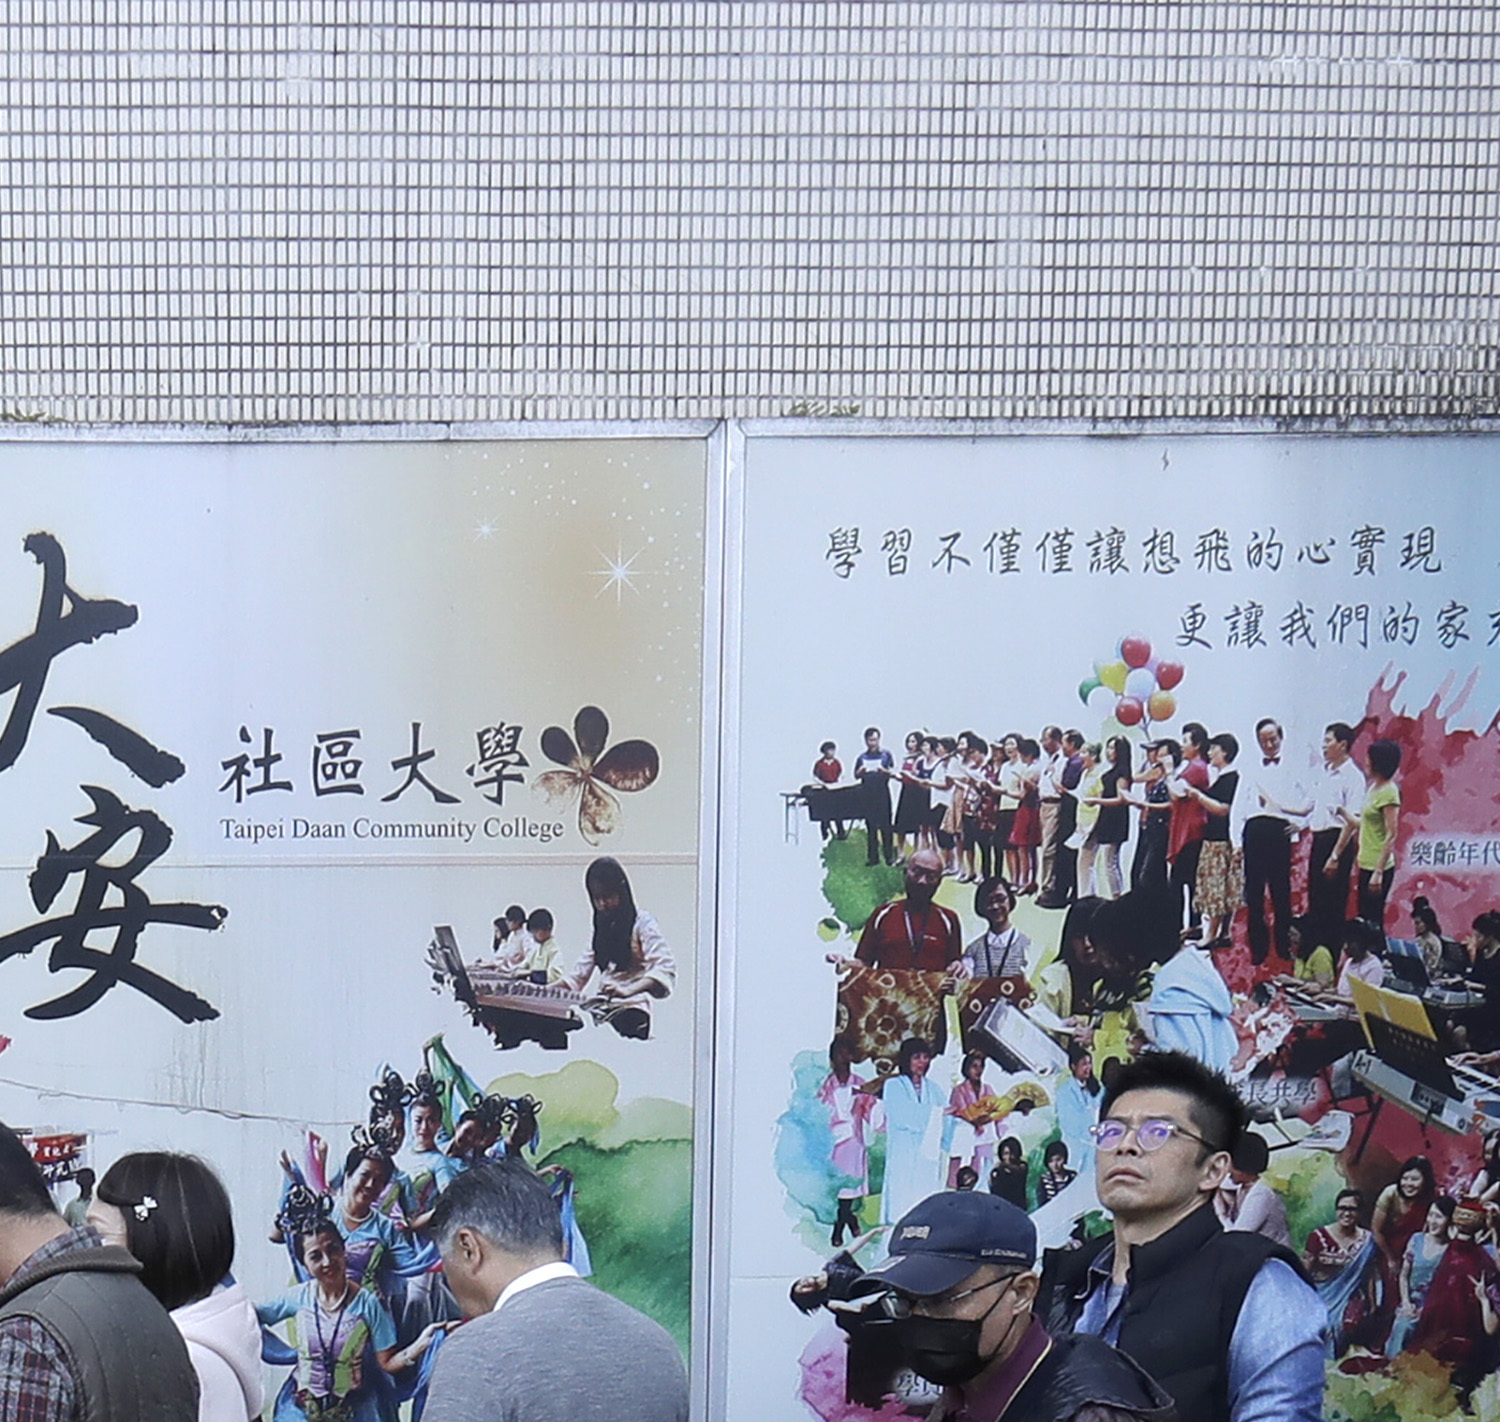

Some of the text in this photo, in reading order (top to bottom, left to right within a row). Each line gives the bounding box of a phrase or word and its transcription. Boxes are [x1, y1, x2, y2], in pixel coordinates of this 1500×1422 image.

[825, 525, 1443, 580] 學習不僅僅讓想飛的心實現
[218, 721, 531, 807] 社區大學
[219, 817, 565, 844] Taipei Daan Community College
[1230, 1080, 1317, 1106] 長共學
